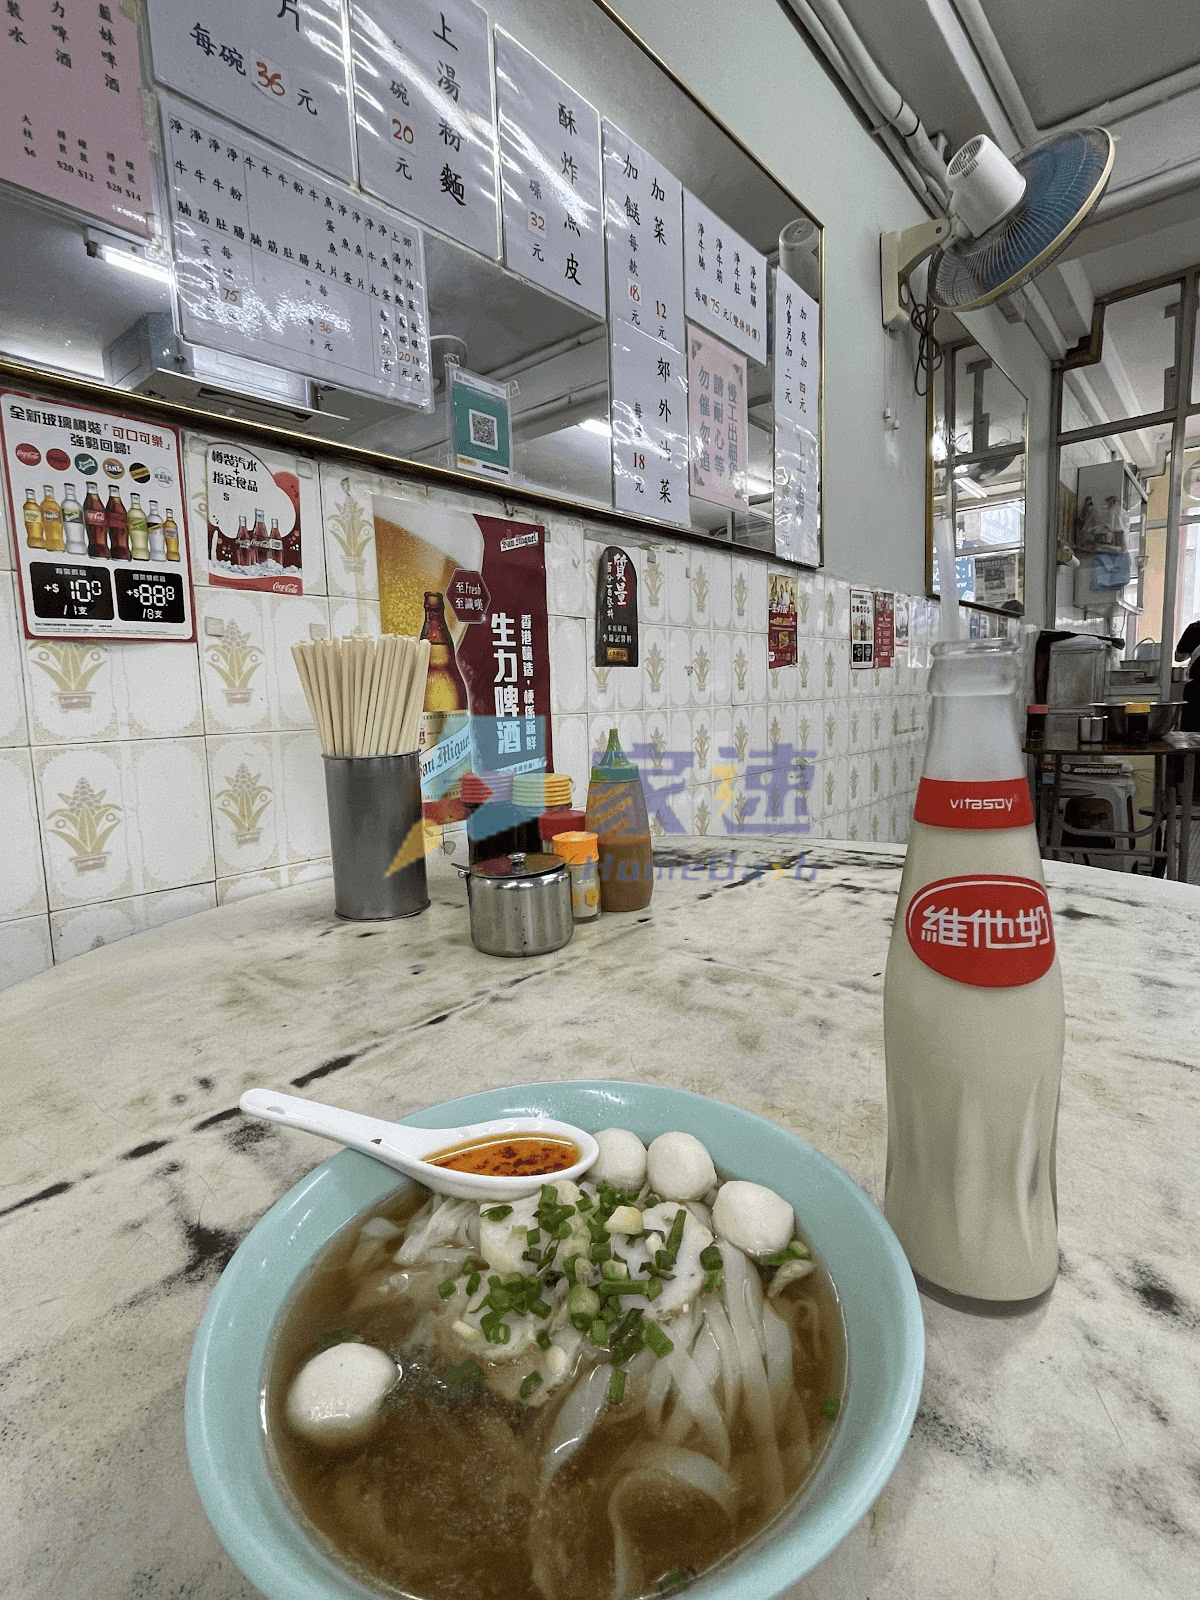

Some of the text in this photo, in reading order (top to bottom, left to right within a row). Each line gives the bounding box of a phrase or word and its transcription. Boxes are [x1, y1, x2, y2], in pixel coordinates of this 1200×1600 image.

[212, 450, 257, 472] 樽裝汽水
[213, 471, 258, 492] 指定食品
[614, 553, 628, 605] 質量
[491, 612, 521, 754] 生力啤酒
[949, 797, 1014, 812] vitasoy
[921, 904, 1050, 949] 維他奶
